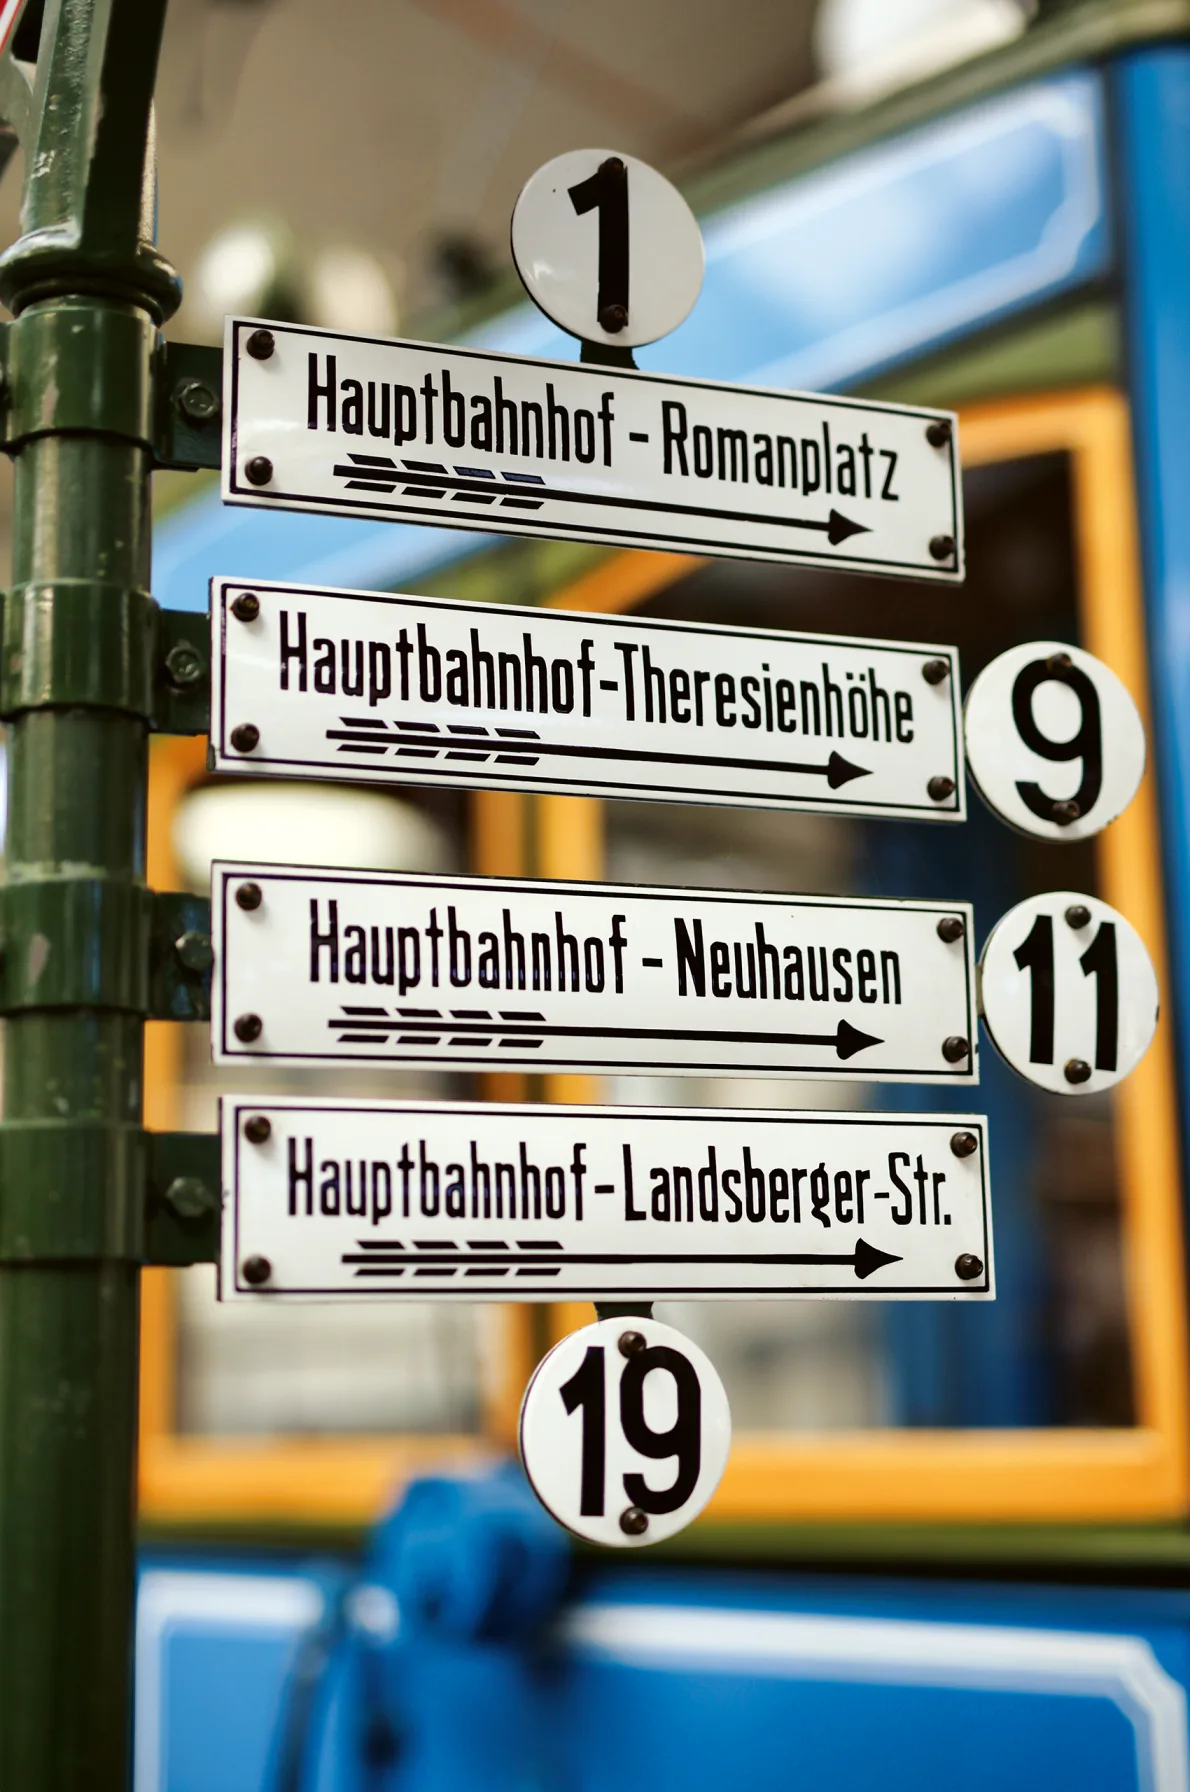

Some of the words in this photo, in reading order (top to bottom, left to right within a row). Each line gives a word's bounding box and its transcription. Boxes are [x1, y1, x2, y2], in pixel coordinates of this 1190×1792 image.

[566, 160, 630, 328] 1
[307, 352, 615, 467] Hauptbahnhof
[661, 399, 900, 501] Romanplatz
[1011, 655, 1104, 822] 9
[309, 898, 628, 998] Hauptbahnhof
[673, 917, 903, 1006] Neuhausen
[1013, 914, 1120, 1073] 11
[558, 1344, 702, 1518] 19
